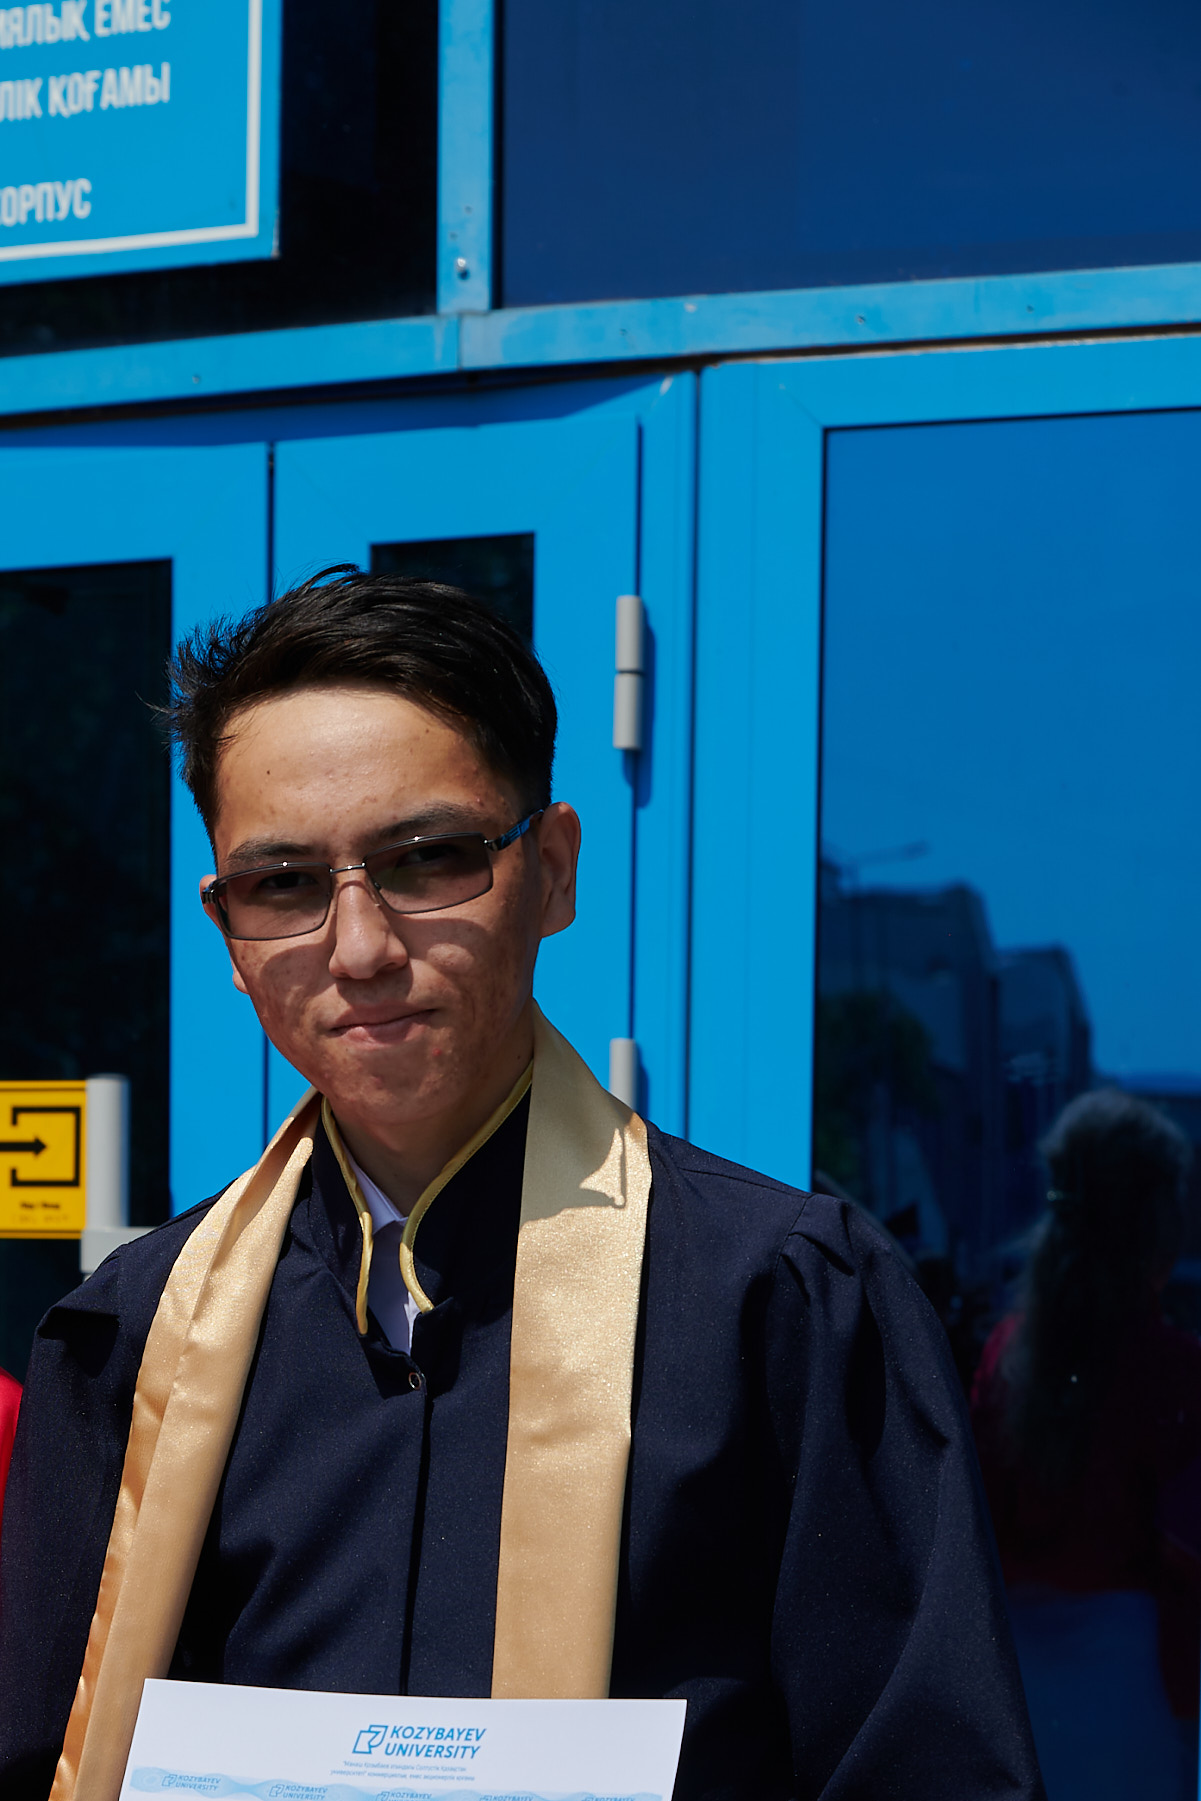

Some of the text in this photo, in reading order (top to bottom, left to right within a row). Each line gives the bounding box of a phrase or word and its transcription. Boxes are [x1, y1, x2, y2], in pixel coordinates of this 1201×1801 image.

[94, 0, 171, 38] ЕМЕС
[390, 1725, 487, 1742] KOZYBAYEV
[384, 1742, 481, 1759] UNIVERSITY
[177, 1775, 221, 1785] KOZYBAYEV
[175, 1782, 218, 1791] UNIVERSITY
[285, 1785, 328, 1794] KOZYBAYEV
[283, 1791, 325, 1800] UNIVERSITY
[390, 1792, 432, 1801] KOZYBAYEV
